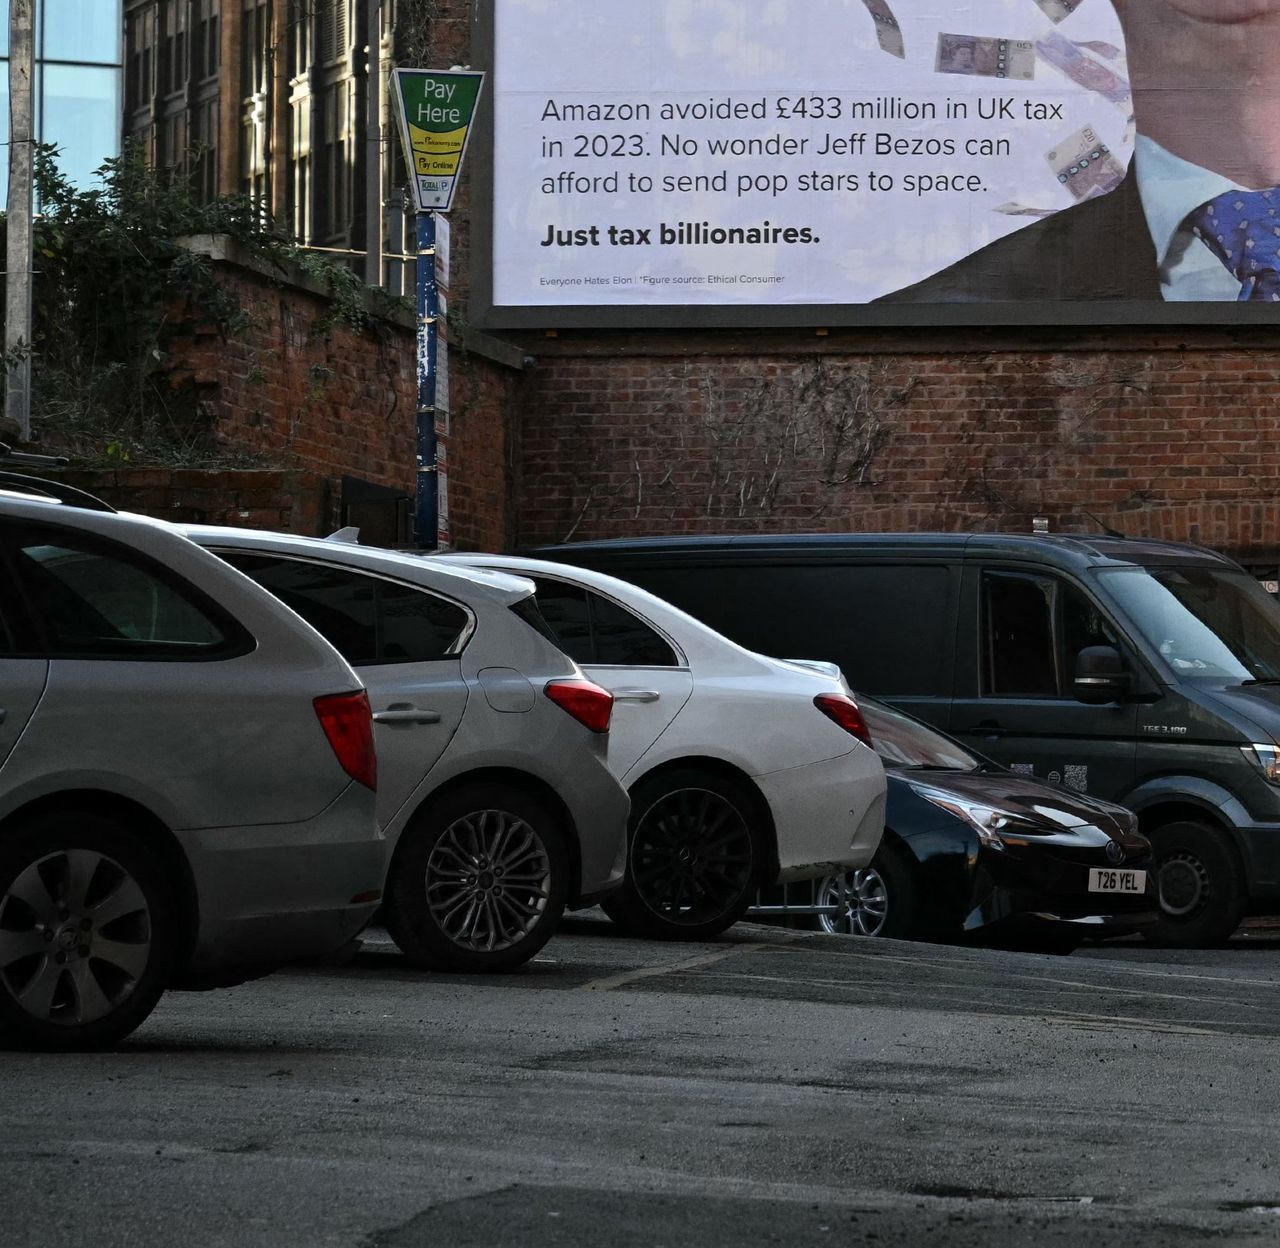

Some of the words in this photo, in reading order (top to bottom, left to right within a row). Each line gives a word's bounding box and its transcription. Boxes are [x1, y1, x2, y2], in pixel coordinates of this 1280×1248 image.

[424, 79, 456, 103] Pay
[418, 103, 460, 123] Here
[540, 99, 650, 122] Amazon
[660, 97, 767, 121] avoided
[775, 96, 842, 120] £433
[852, 96, 936, 120] million
[946, 97, 967, 119] in
[977, 97, 1016, 120] UK
[1023, 99, 1063, 121] tax
[542, 135, 563, 158] in
[661, 133, 698, 156] No
[707, 133, 809, 156] wonder
[816, 132, 868, 156] Jeff
[875, 132, 956, 156] Bezos
[965, 138, 1010, 156] can
[418, 157, 430, 170] Pay
[432, 161, 454, 169] Online
[541, 170, 618, 194] afford
[627, 172, 653, 193] to
[662, 169, 727, 193] send
[737, 174, 788, 198] pop
[797, 170, 859, 192] stars
[867, 170, 894, 192] to
[903, 174, 988, 197] space.
[540, 224, 600, 247] Just
[607, 225, 652, 246] tax
[659, 220, 821, 245] billionaires.
[539, 277, 582, 287] Everyone
[584, 276, 610, 285] Hates
[612, 275, 633, 284] Elon
[672, 275, 705, 284] source:
[707, 274, 737, 284] Ethical
[739, 274, 785, 284] Consumer
[1097, 871, 1117, 889] T26
[1119, 872, 1138, 891] YEL
